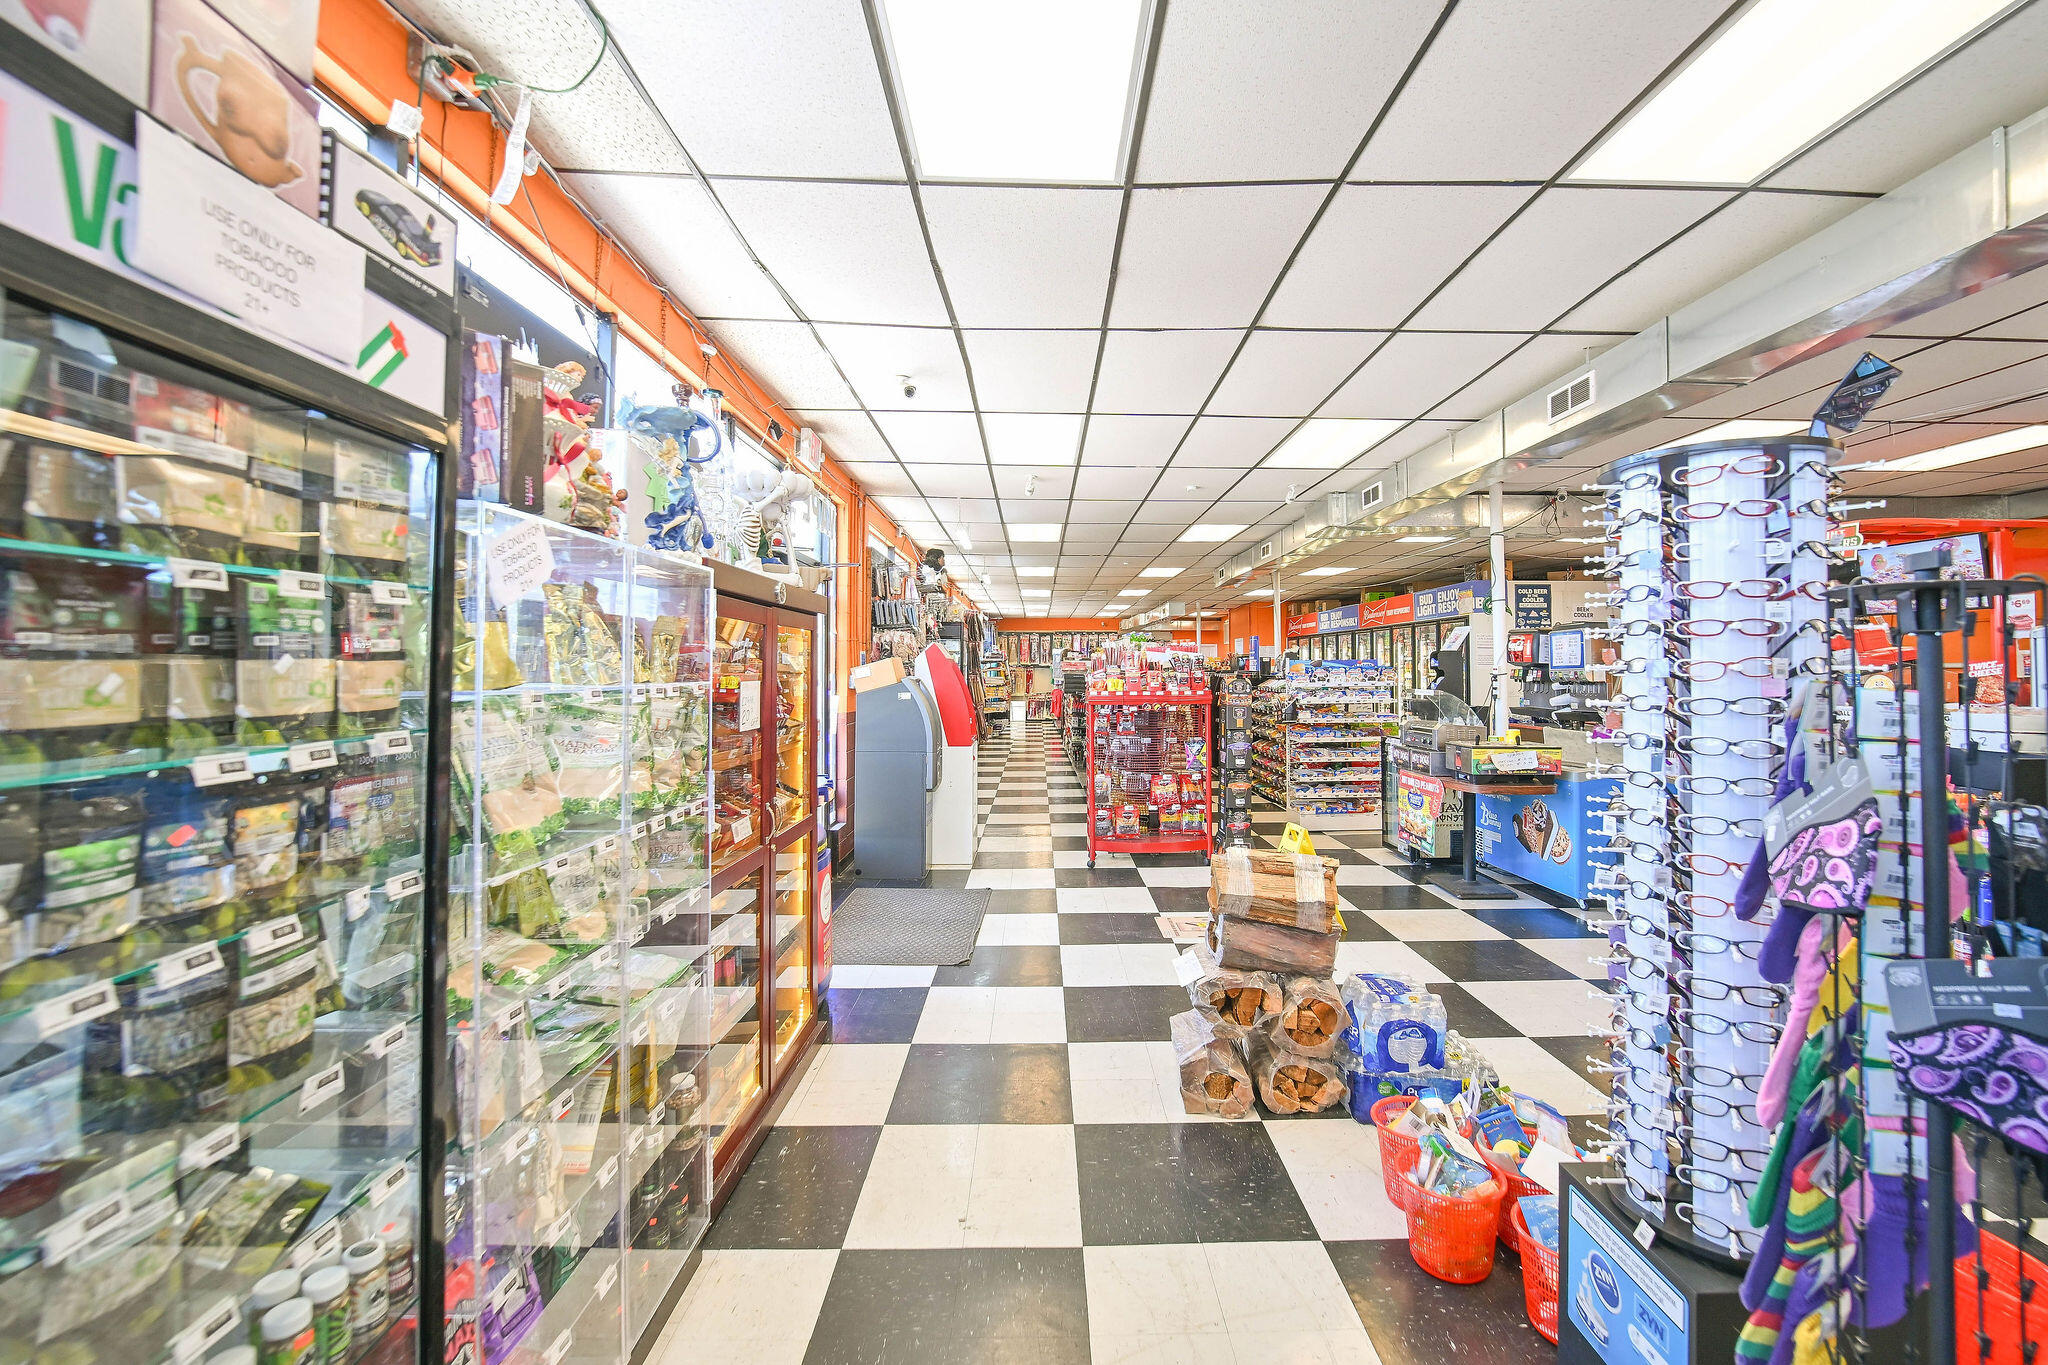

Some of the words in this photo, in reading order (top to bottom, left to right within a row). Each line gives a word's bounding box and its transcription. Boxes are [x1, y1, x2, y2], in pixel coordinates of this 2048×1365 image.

[201, 196, 237, 230] USE
[240, 219, 282, 250] ONLY
[285, 243, 316, 272] FOR
[220, 230, 298, 284] TOBACCO
[214, 252, 301, 308] PRODUCTS
[502, 554, 544, 586] PRODUCTS
[1417, 603, 1438, 617] LIGHT
[1419, 593, 1433, 605] BUD
[1437, 588, 1460, 603] ENJOY
[1968, 668, 2003, 678] CHEESE
[1969, 660, 1998, 670] TWICE
[1592, 1262, 1613, 1286] ZYN
[1638, 1303, 1664, 1342] ZYN
